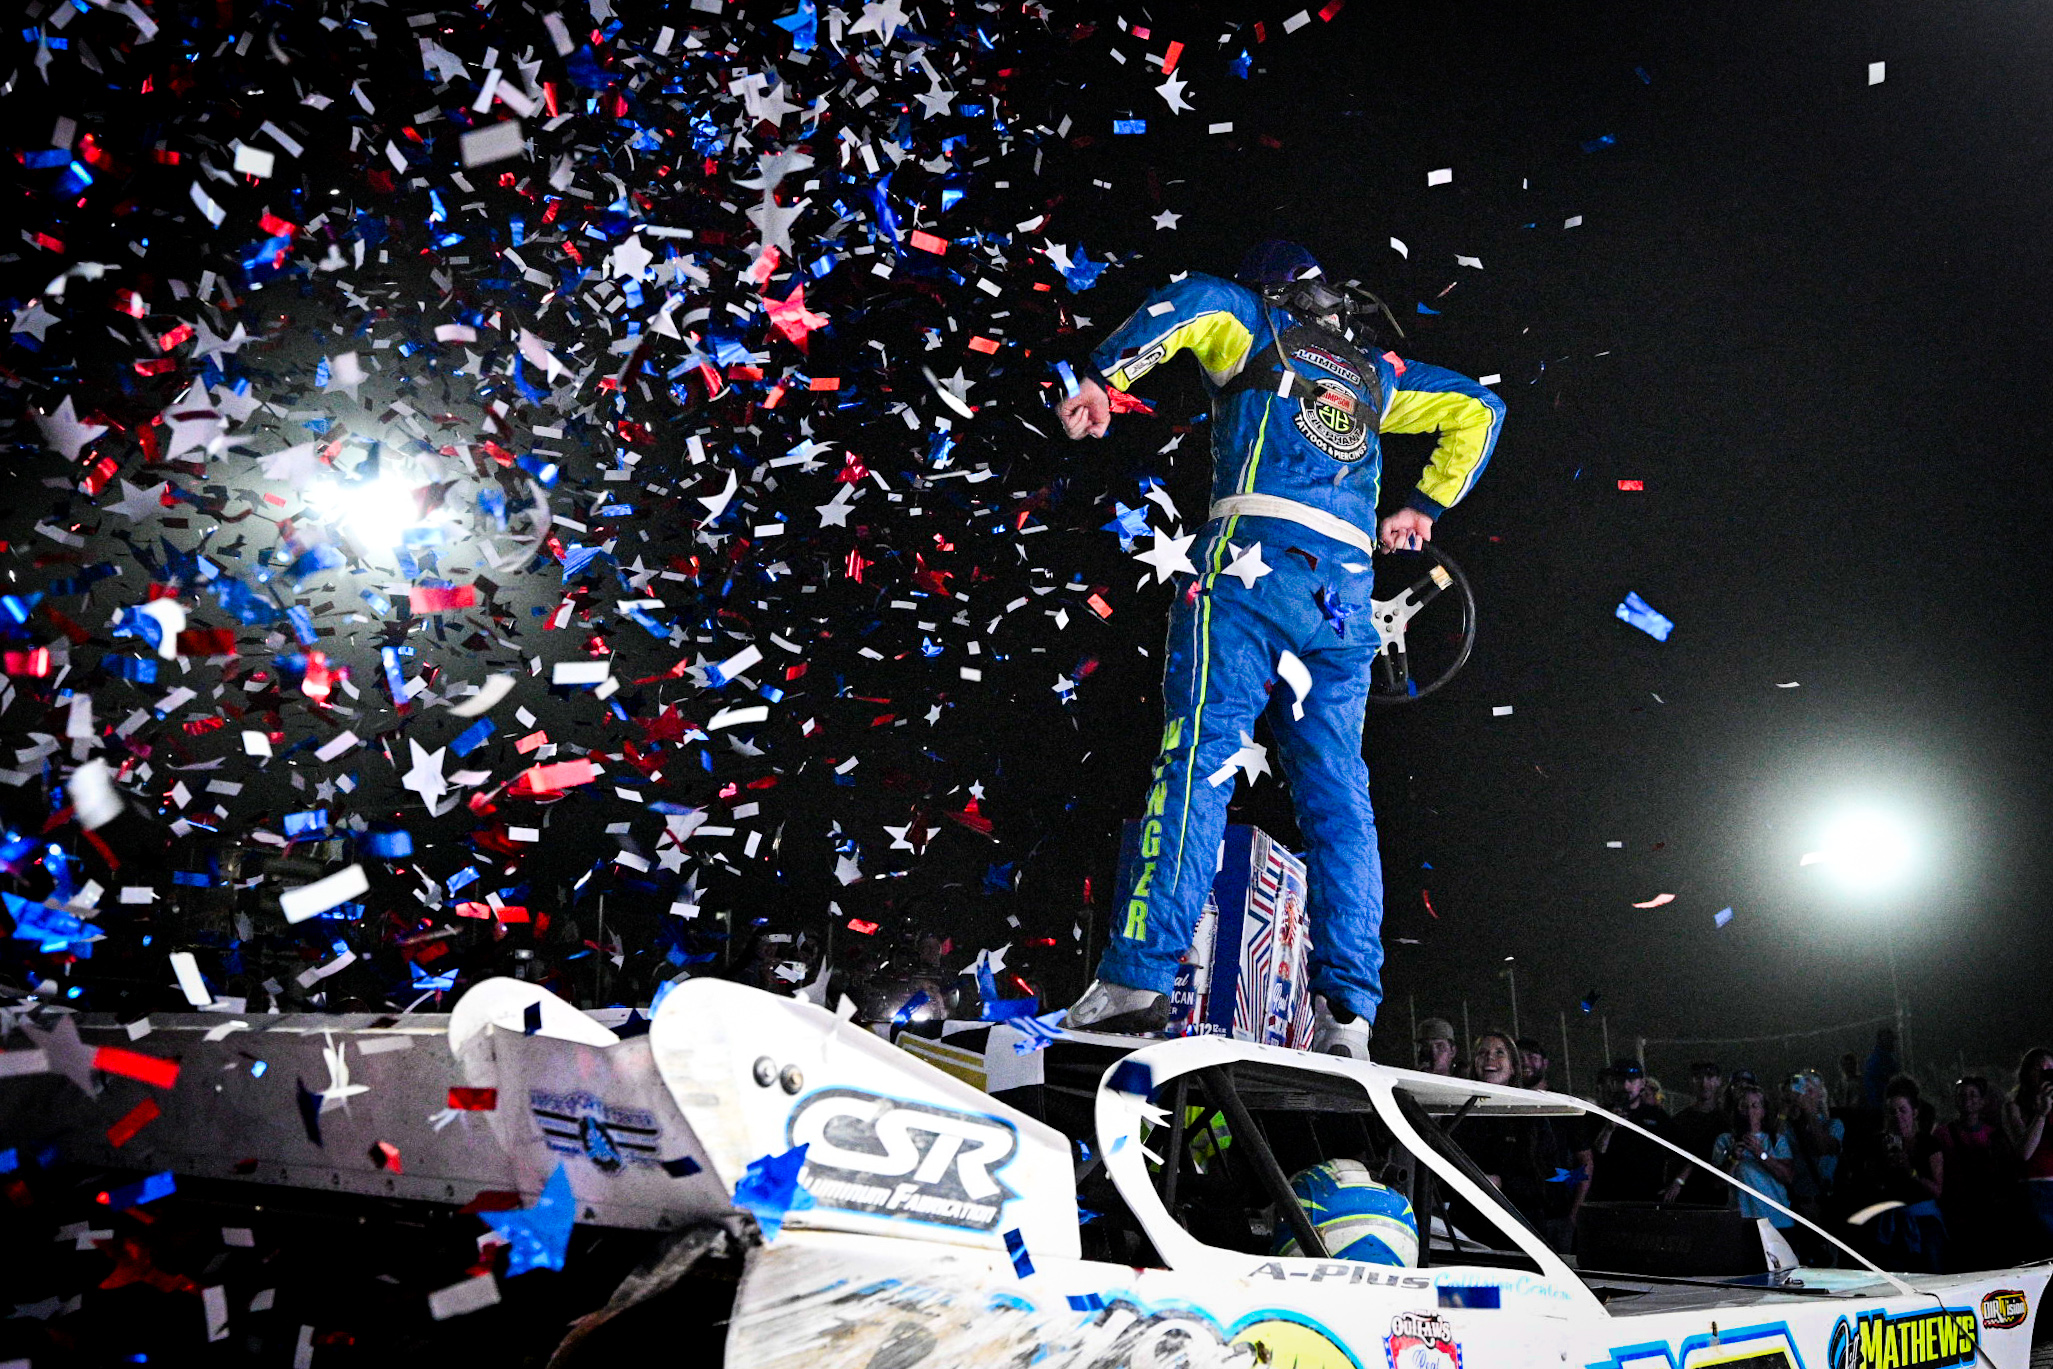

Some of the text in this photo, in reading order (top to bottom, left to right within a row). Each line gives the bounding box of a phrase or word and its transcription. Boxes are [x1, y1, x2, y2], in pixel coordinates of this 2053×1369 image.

[1296, 349, 1360, 384] LUMBING
[1295, 414, 1328, 452] TATTOOS
[1334, 443, 1367, 461] PIERCINGS
[1171, 990, 1195, 1006] ICAN
[1174, 974, 1190, 987] al
[793, 1096, 1013, 1200] CSR
[1249, 1261, 1430, 1289] A-Plus
[1859, 1315, 1976, 1369] MATHEWS
